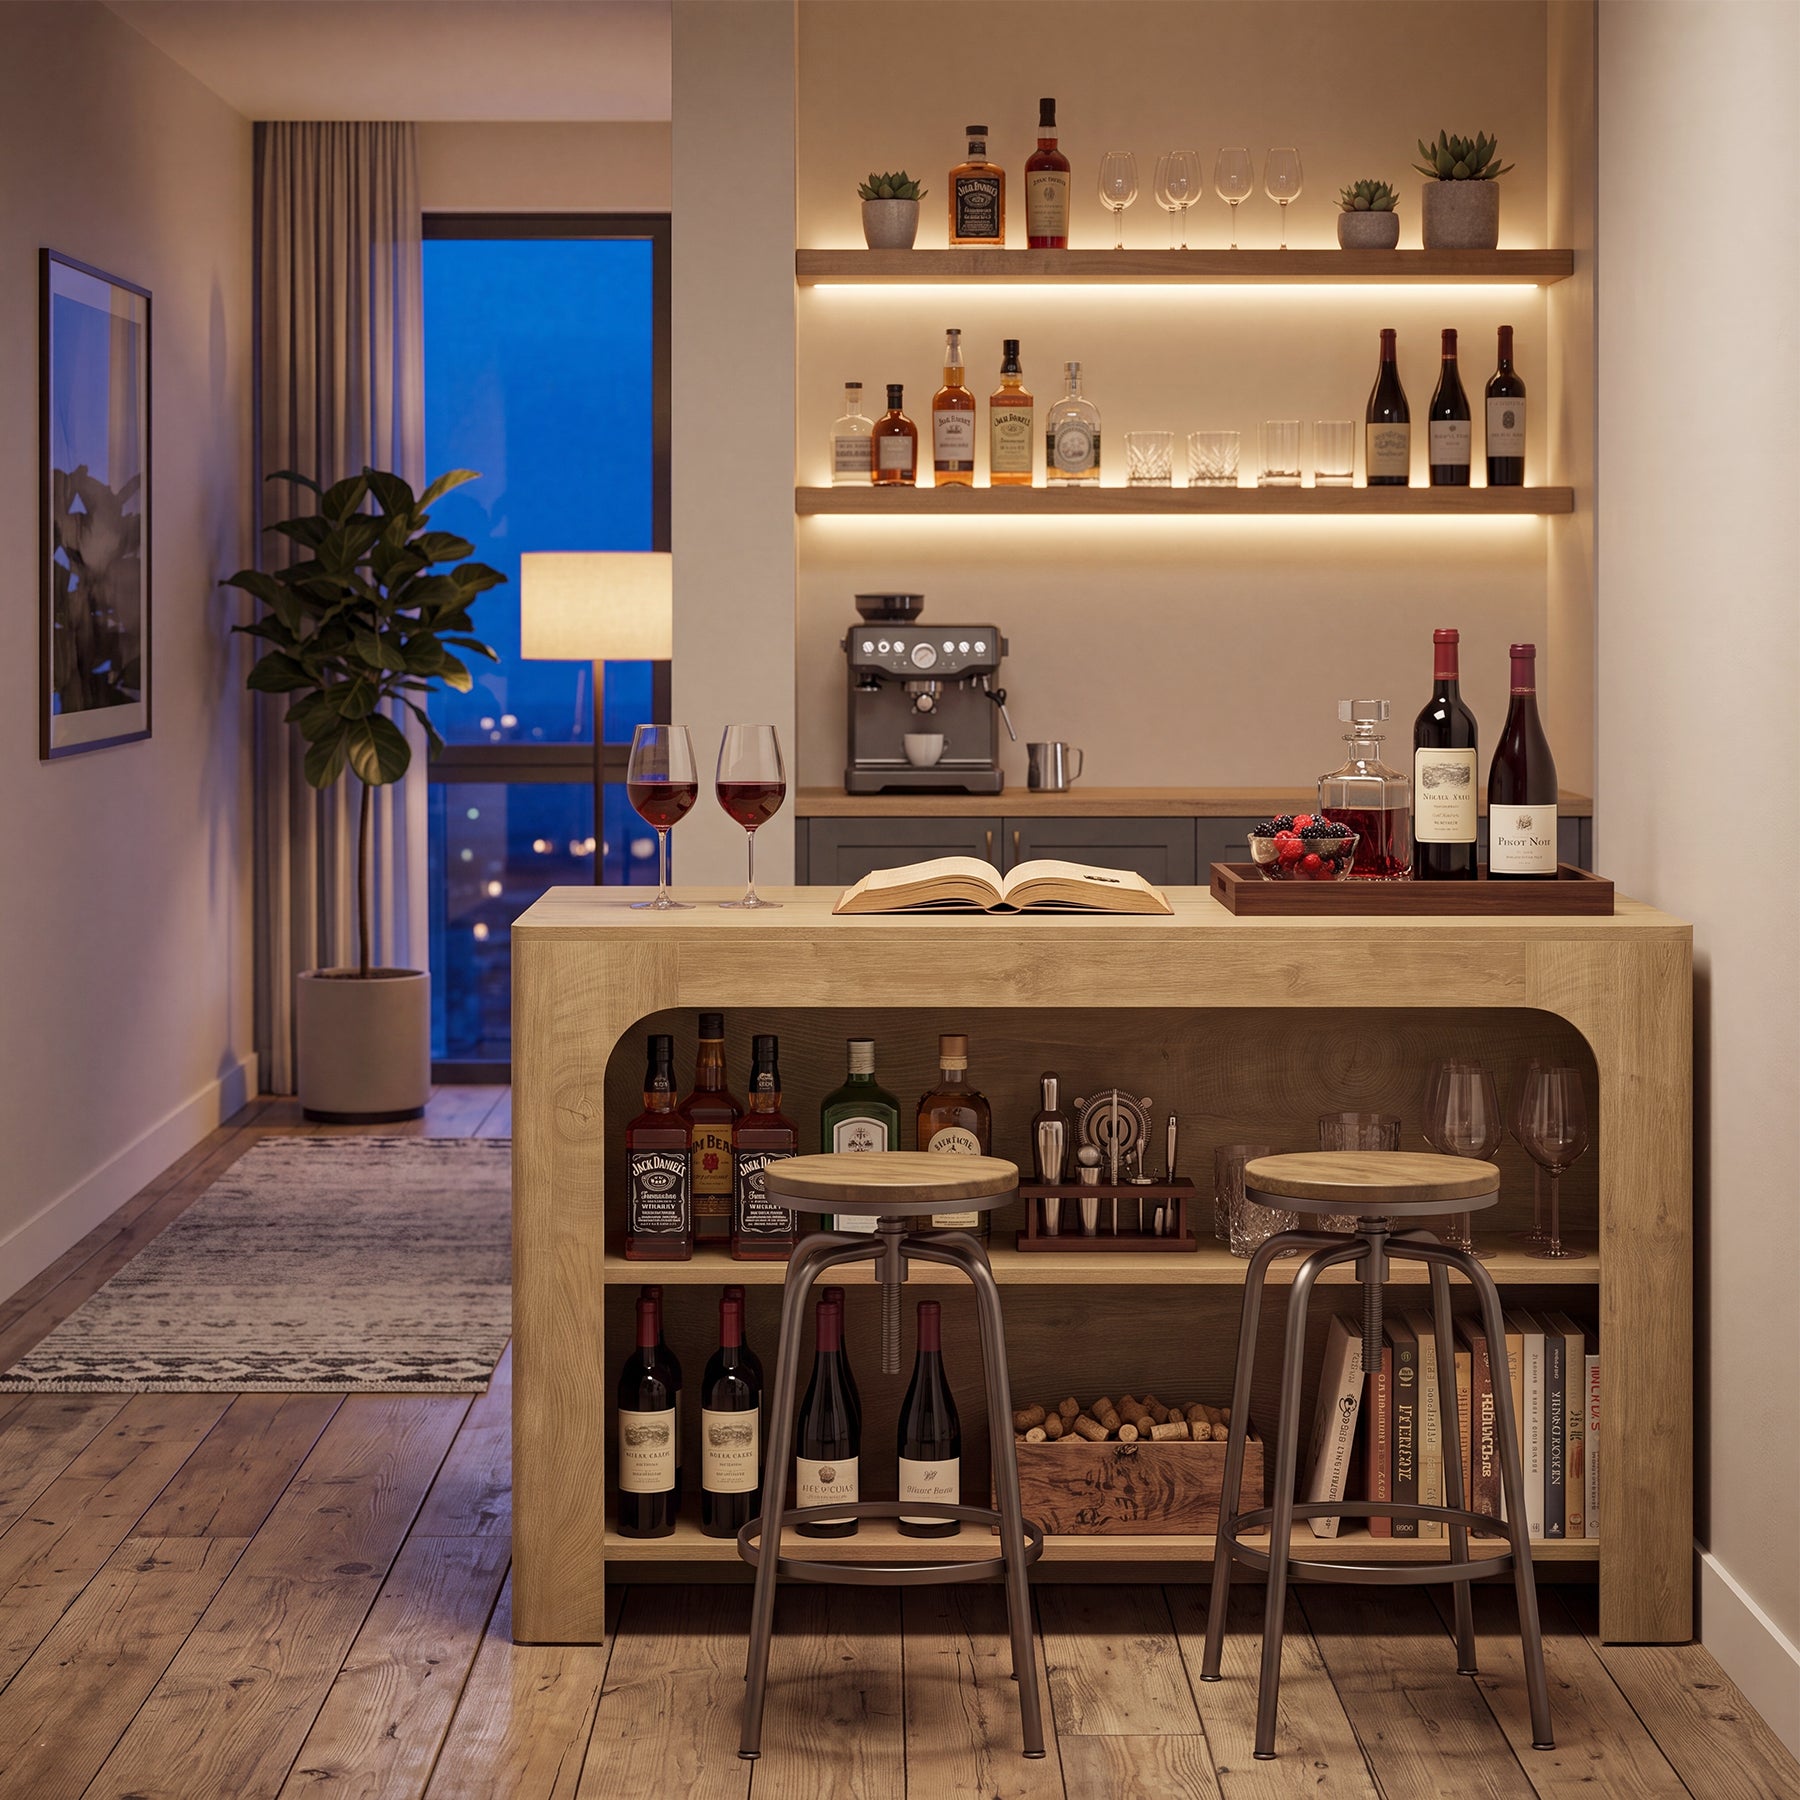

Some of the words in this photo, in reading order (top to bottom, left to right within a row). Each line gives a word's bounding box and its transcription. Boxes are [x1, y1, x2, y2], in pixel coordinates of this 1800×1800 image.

[707, 1134, 732, 1156] BEA
[632, 1159, 654, 1177] JACK
[739, 1159, 760, 1177] JACK
